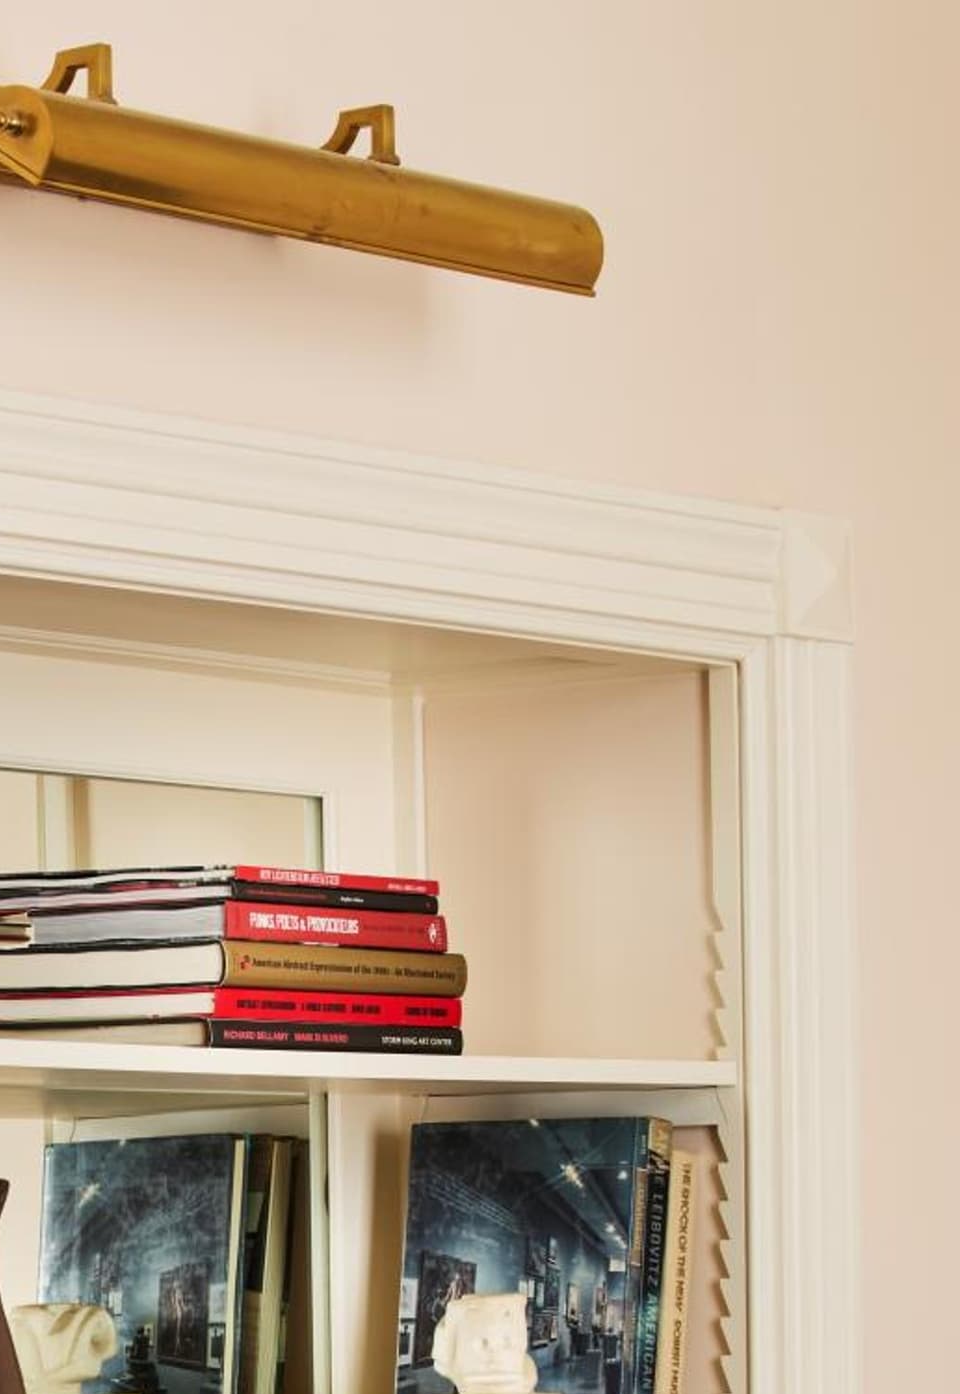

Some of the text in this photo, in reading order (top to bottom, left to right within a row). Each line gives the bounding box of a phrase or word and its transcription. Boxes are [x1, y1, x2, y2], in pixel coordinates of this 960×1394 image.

[681, 1163, 692, 1186] THE
[678, 1187, 691, 1235] SHOCK
[647, 1193, 664, 1287] LEIBOVITZ
[678, 1236, 688, 1253] OF
[642, 1293, 659, 1390] AMERICAN
